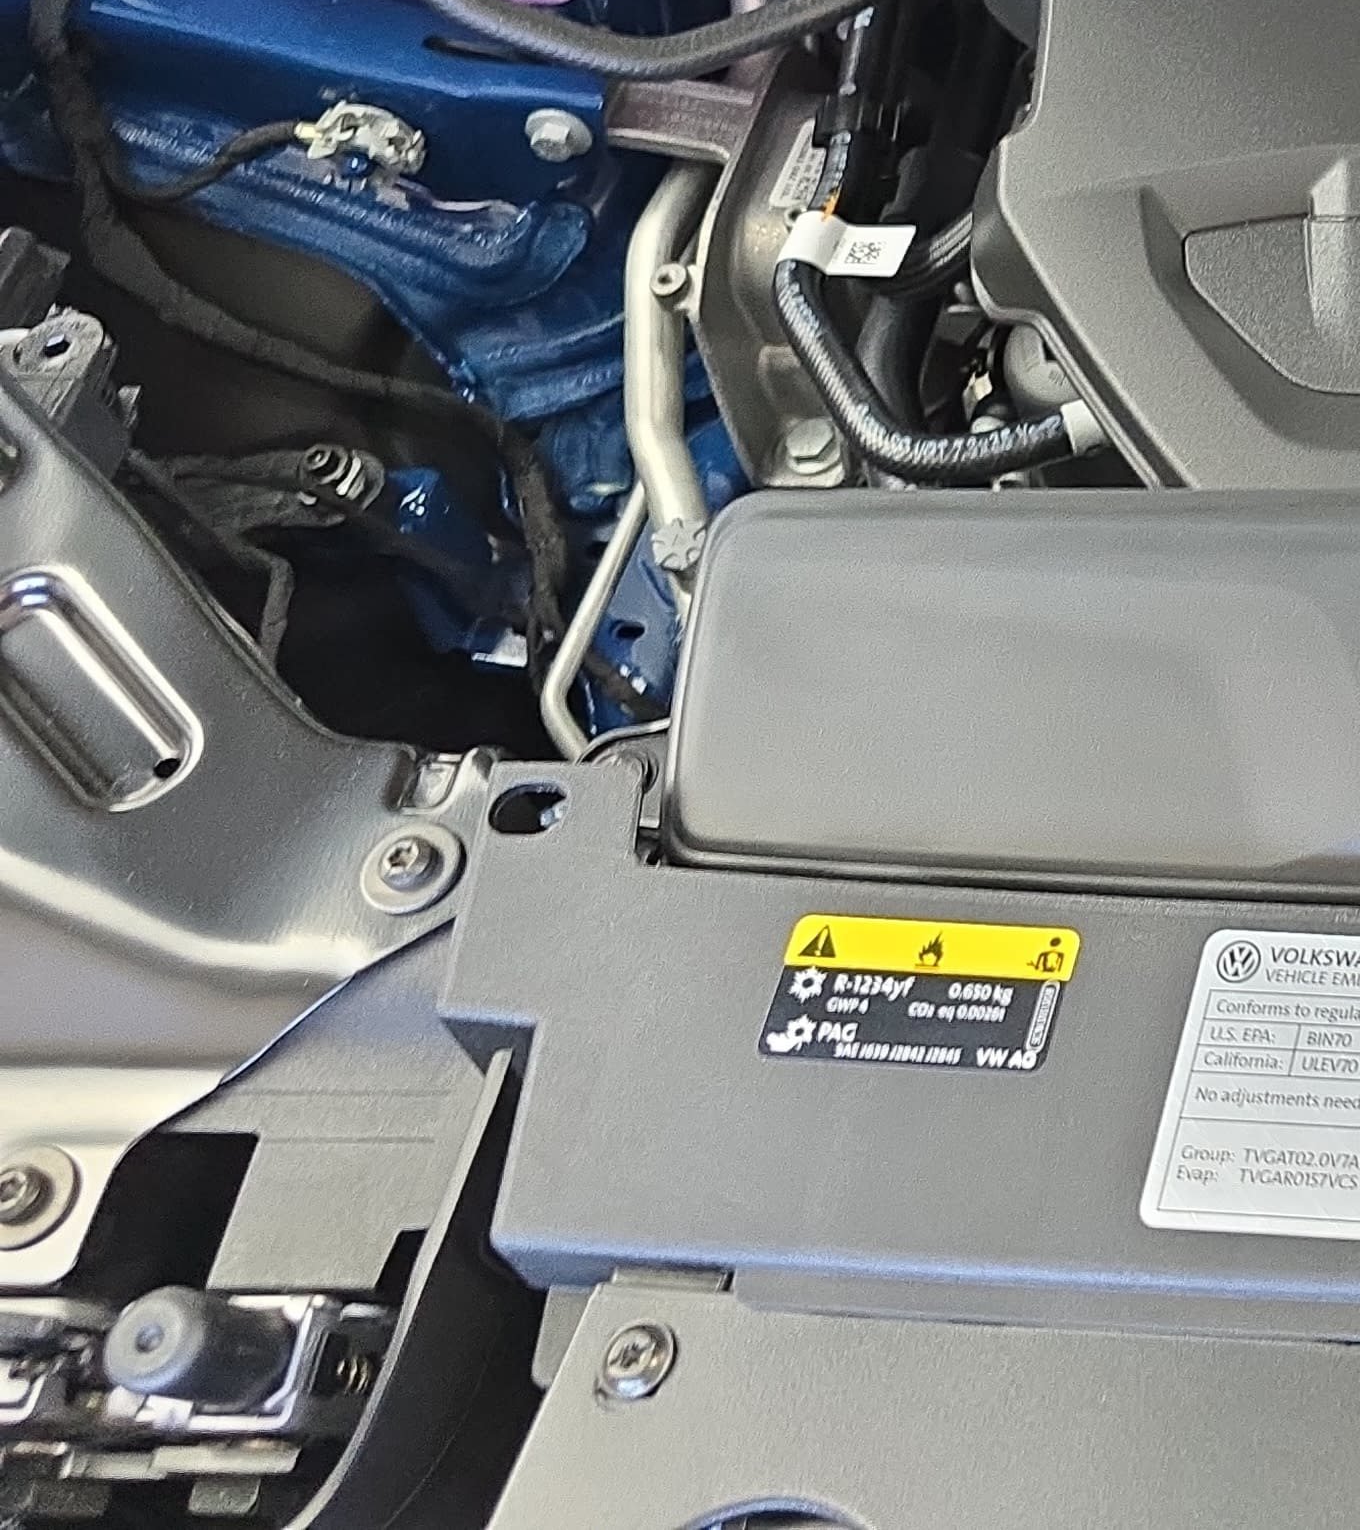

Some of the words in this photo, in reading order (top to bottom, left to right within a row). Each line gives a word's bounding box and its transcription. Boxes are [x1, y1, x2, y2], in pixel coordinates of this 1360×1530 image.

[1265, 968, 1326, 986] VEHICLE
[833, 973, 916, 1001] R-1234yf
[992, 983, 1014, 1007] kg
[826, 996, 859, 1014] GWP
[1217, 998, 1290, 1017] Conforms
[1295, 1002, 1309, 1018] to
[816, 1021, 858, 1043] PAG
[1210, 1026, 1236, 1042] U.S.
[1242, 1027, 1276, 1044] EPA:
[1307, 1031, 1353, 1049] BIN70
[976, 1047, 1009, 1068] VW
[1008, 1049, 1037, 1070] AG
[1204, 1050, 1284, 1070] California:
[1302, 1056, 1359, 1074] ULEV70
[1195, 1086, 1219, 1102] No
[1221, 1086, 1320, 1108] adjustments
[1181, 1144, 1236, 1166] Group:
[1176, 1165, 1219, 1186] Evap:
